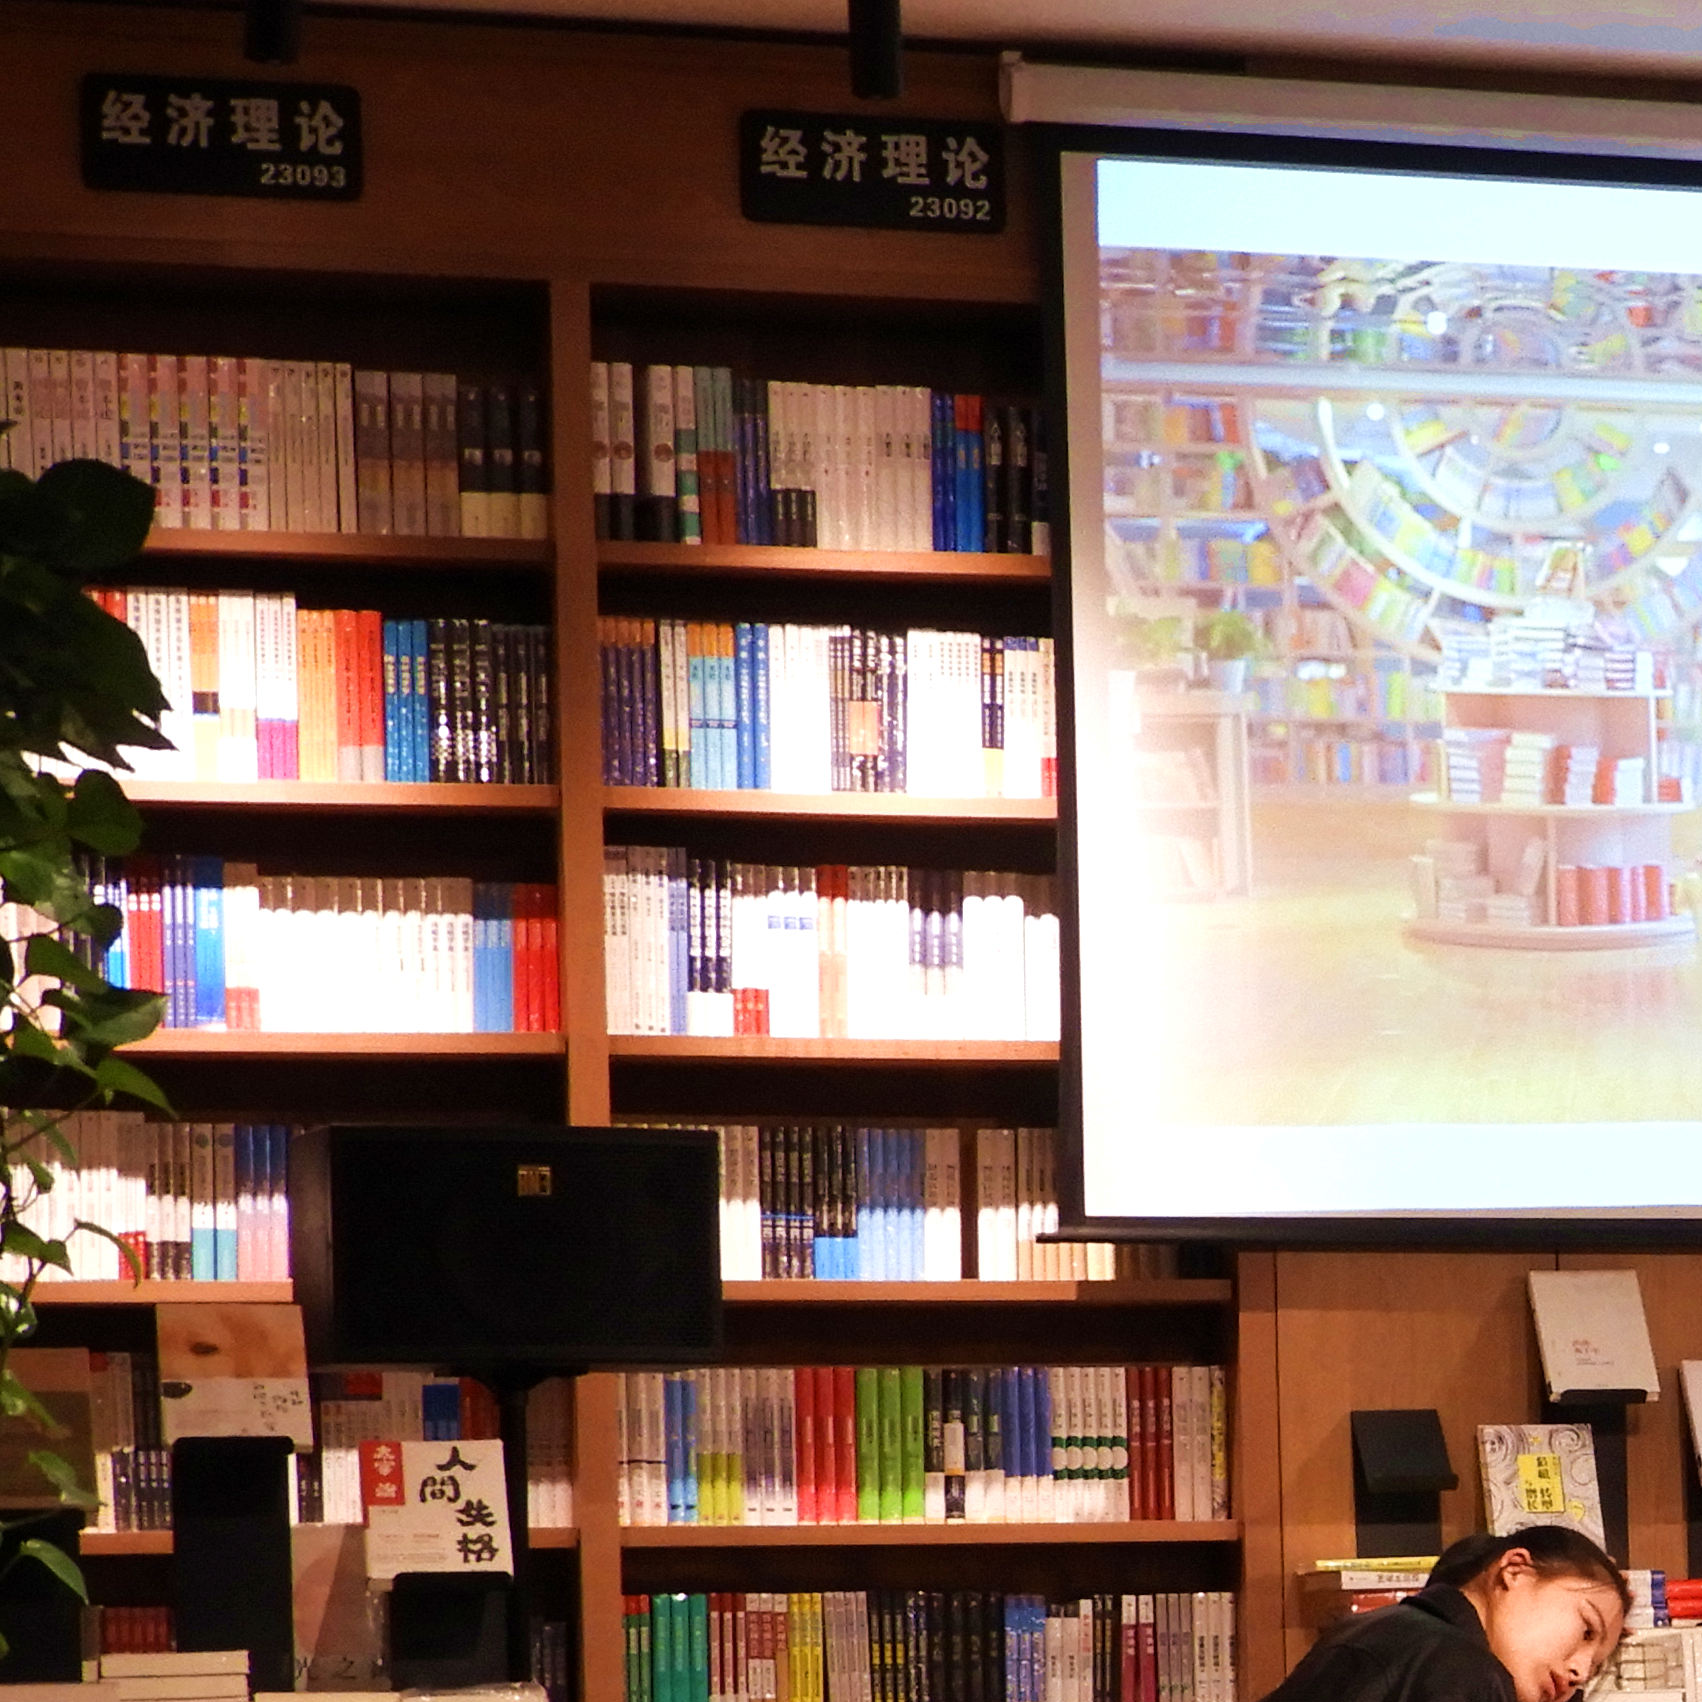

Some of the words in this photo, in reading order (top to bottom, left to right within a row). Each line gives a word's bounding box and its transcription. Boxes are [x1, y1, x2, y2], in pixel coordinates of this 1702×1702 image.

[101, 89, 346, 156] 经济理论
[259, 162, 347, 190] 23093
[760, 126, 991, 191] 经济理论
[908, 197, 992, 223] 23092
